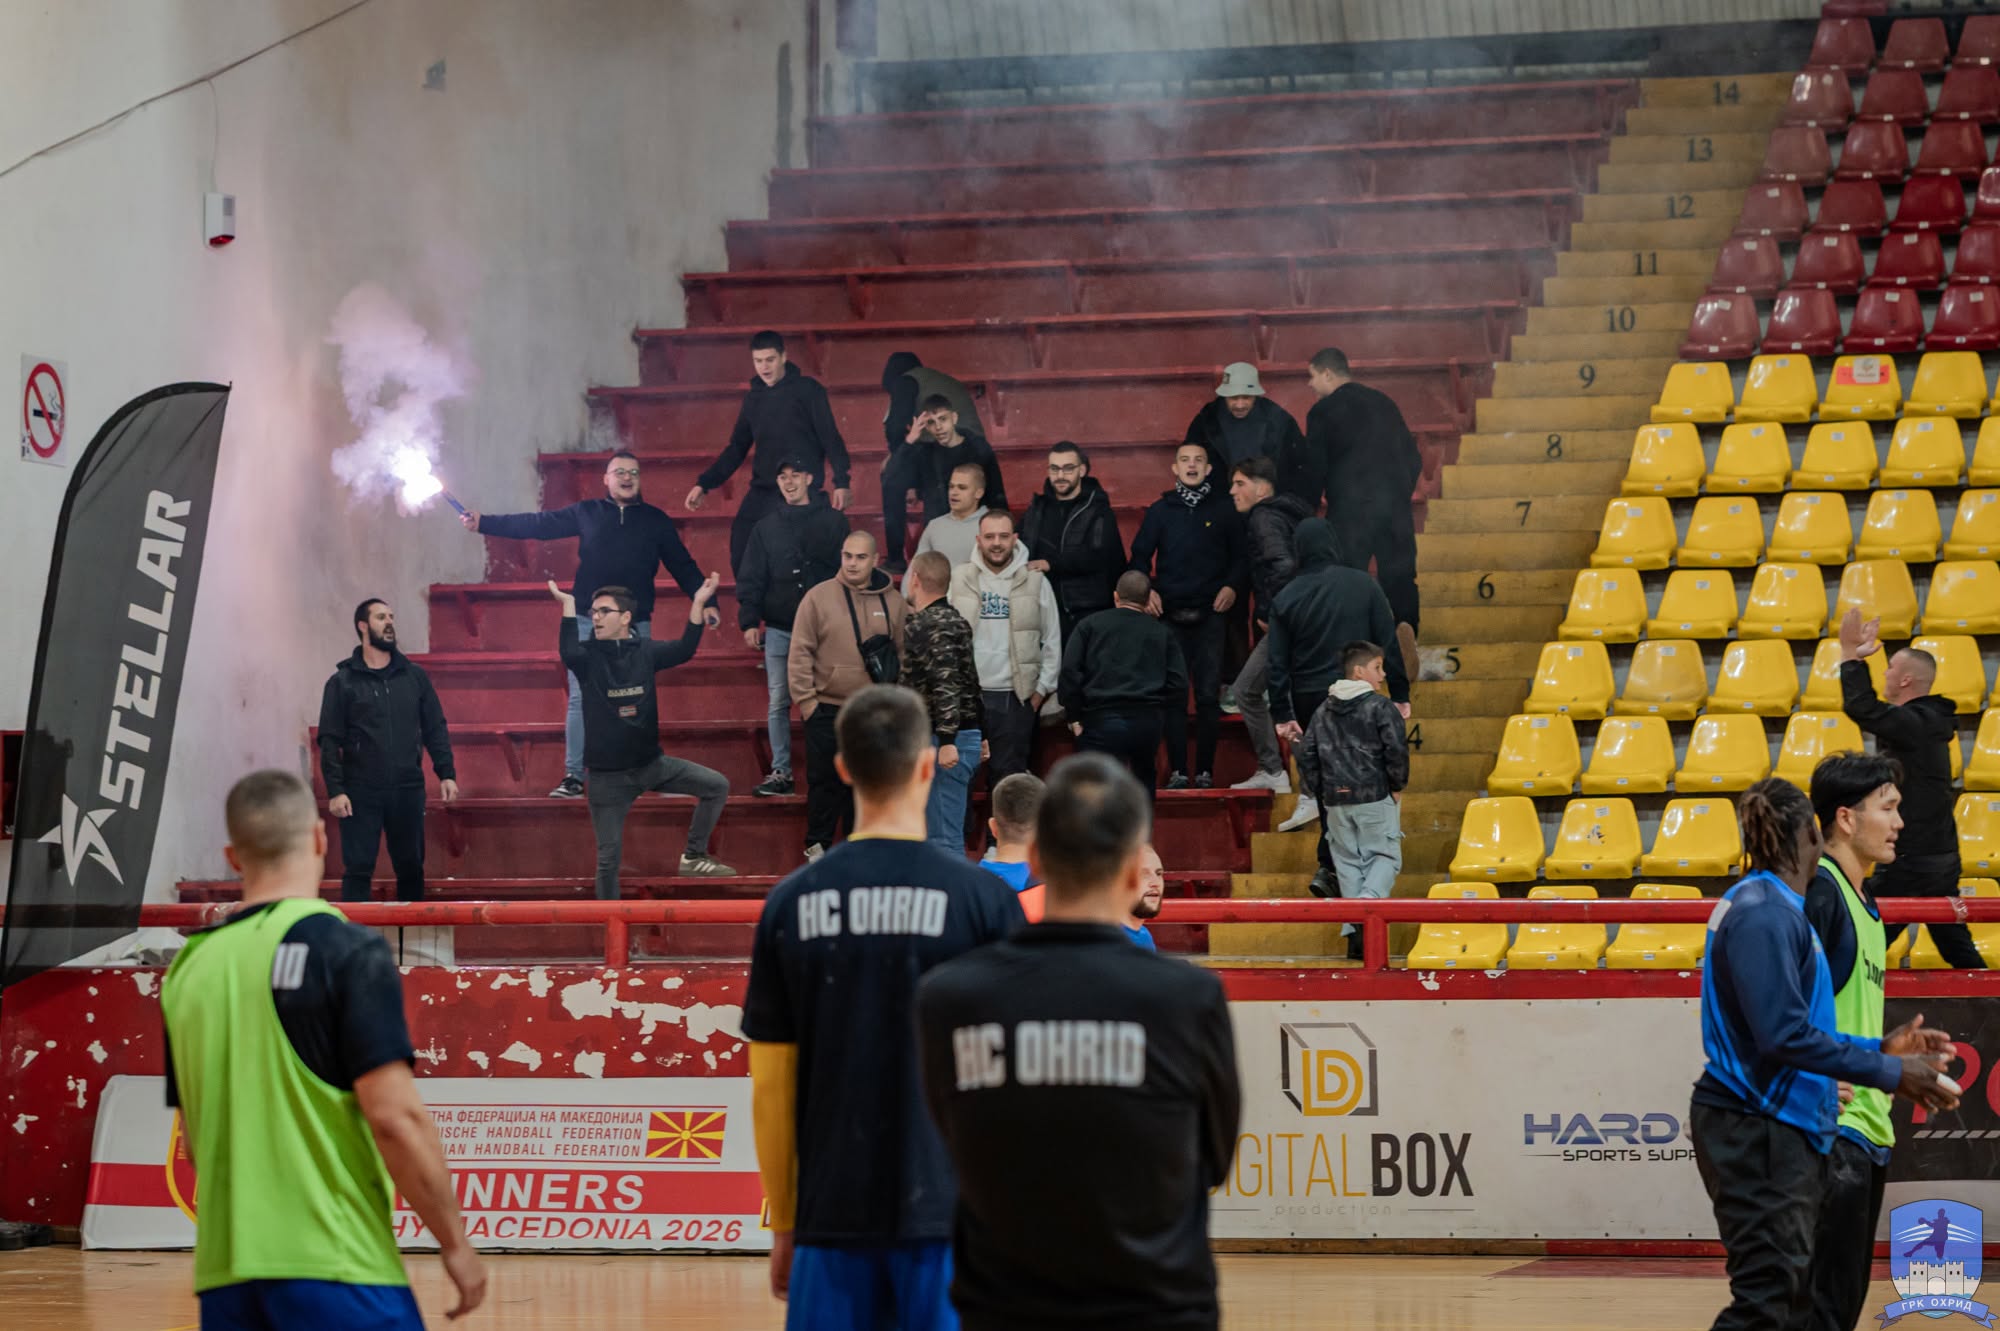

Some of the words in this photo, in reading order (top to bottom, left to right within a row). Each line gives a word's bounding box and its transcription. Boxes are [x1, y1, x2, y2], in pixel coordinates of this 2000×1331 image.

[1712, 80, 1741, 106] 14
[1687, 137, 1713, 162] 13
[1667, 194, 1695, 219] 12
[1633, 253, 1658, 276] 11
[1607, 306, 1636, 332] 10
[1579, 364, 1596, 388] 9
[1546, 433, 1562, 459] 8
[1514, 501, 1532, 526] 7
[1477, 573, 1495, 600] 6
[99, 489, 192, 811] STELLAR
[1446, 647, 1461, 674] 5
[1407, 723, 1423, 750] 4
[798, 887, 842, 942] HC
[848, 885, 949, 938] OHRID
[272, 942, 310, 991] ID
[952, 1021, 1006, 1092] HC
[1014, 1019, 1147, 1088] OHRID
[430, 1110, 453, 1122] ТНА
[457, 1109, 536, 1124] ФЕДЕРАЦИЈА
[540, 1111, 556, 1123] НА
[560, 1111, 644, 1125] МАКЕДОНИЈА
[486, 1126, 553, 1139] HANDBALL
[562, 1127, 642, 1140] FEDERATION
[474, 1143, 546, 1156] HANDBALL
[554, 1144, 641, 1157] FEDERATION
[1562, 1149, 1642, 1162] SPORTS
[1274, 1203, 1393, 1217] production
[461, 1215, 652, 1241] ACEDONIA
[661, 1218, 744, 1244] 2026
